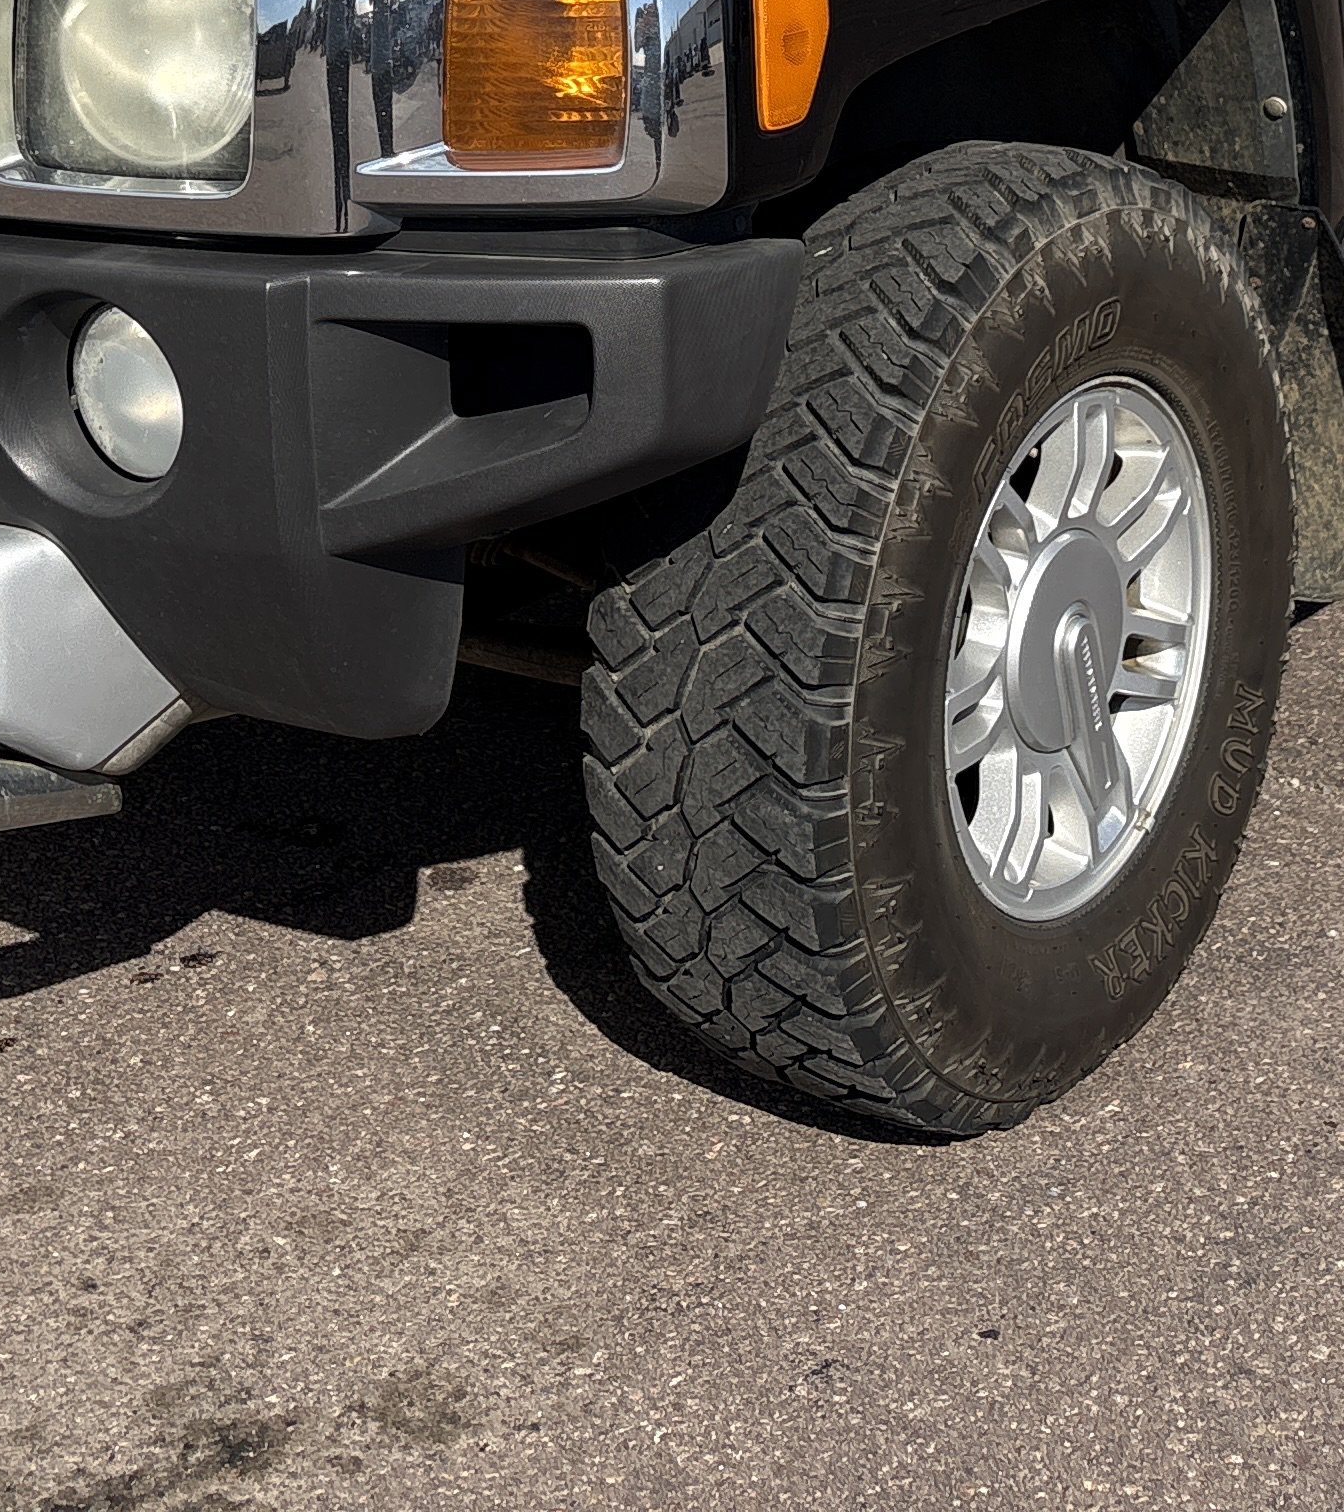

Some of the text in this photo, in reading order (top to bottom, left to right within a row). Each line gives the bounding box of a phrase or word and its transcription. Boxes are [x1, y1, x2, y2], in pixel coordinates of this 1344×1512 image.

[972, 296, 1121, 503] COSMO
[1209, 680, 1266, 817] MUD
[1088, 822, 1220, 1001] KICKER
